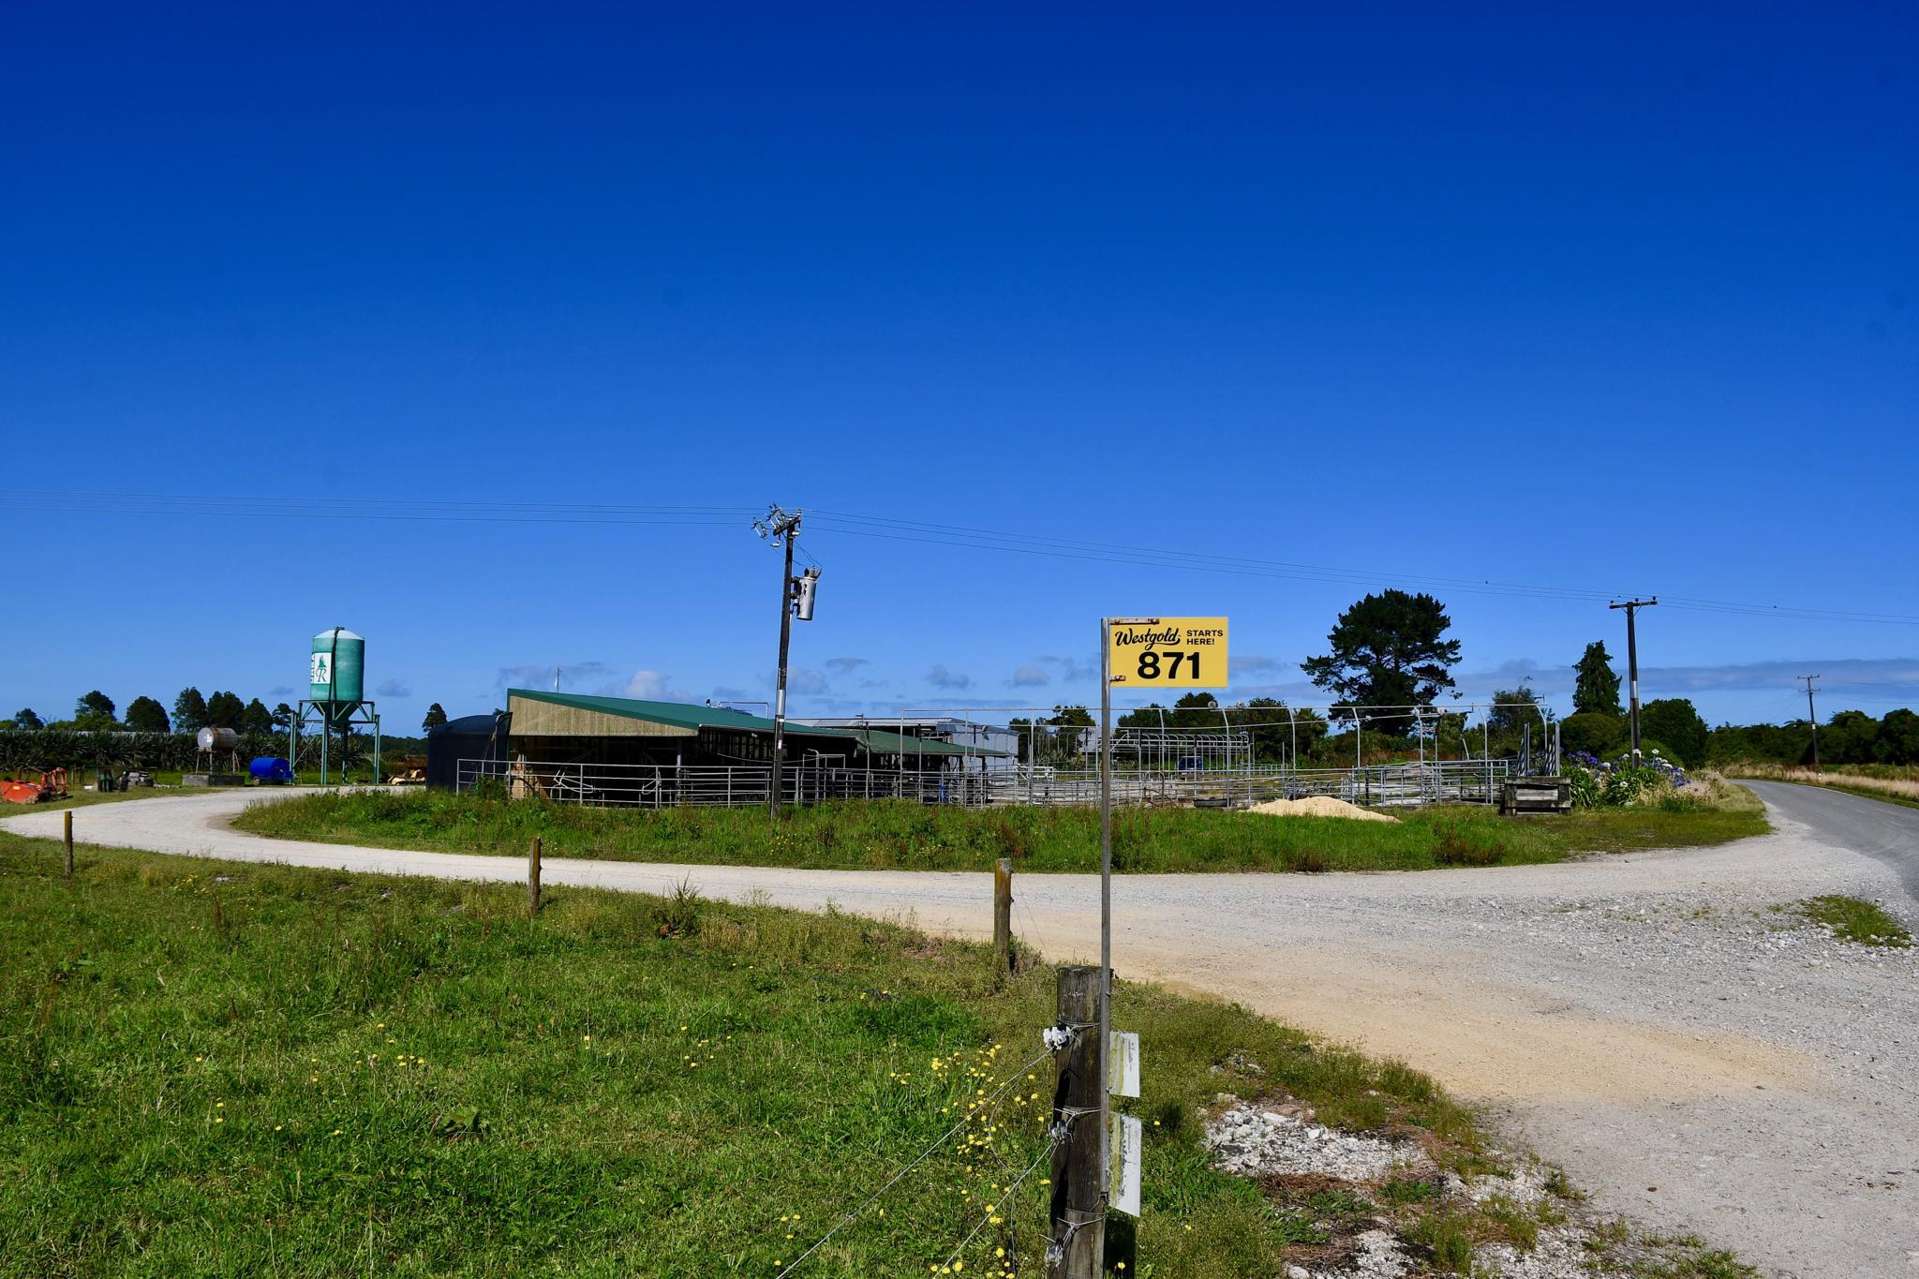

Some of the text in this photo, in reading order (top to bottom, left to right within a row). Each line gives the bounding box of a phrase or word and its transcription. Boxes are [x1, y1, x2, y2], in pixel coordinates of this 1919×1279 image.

[1115, 627, 1180, 650] Westgold
[1186, 629, 1223, 637] STARTS
[1186, 637, 1215, 645] HERE!
[1137, 651, 1200, 679] 871
